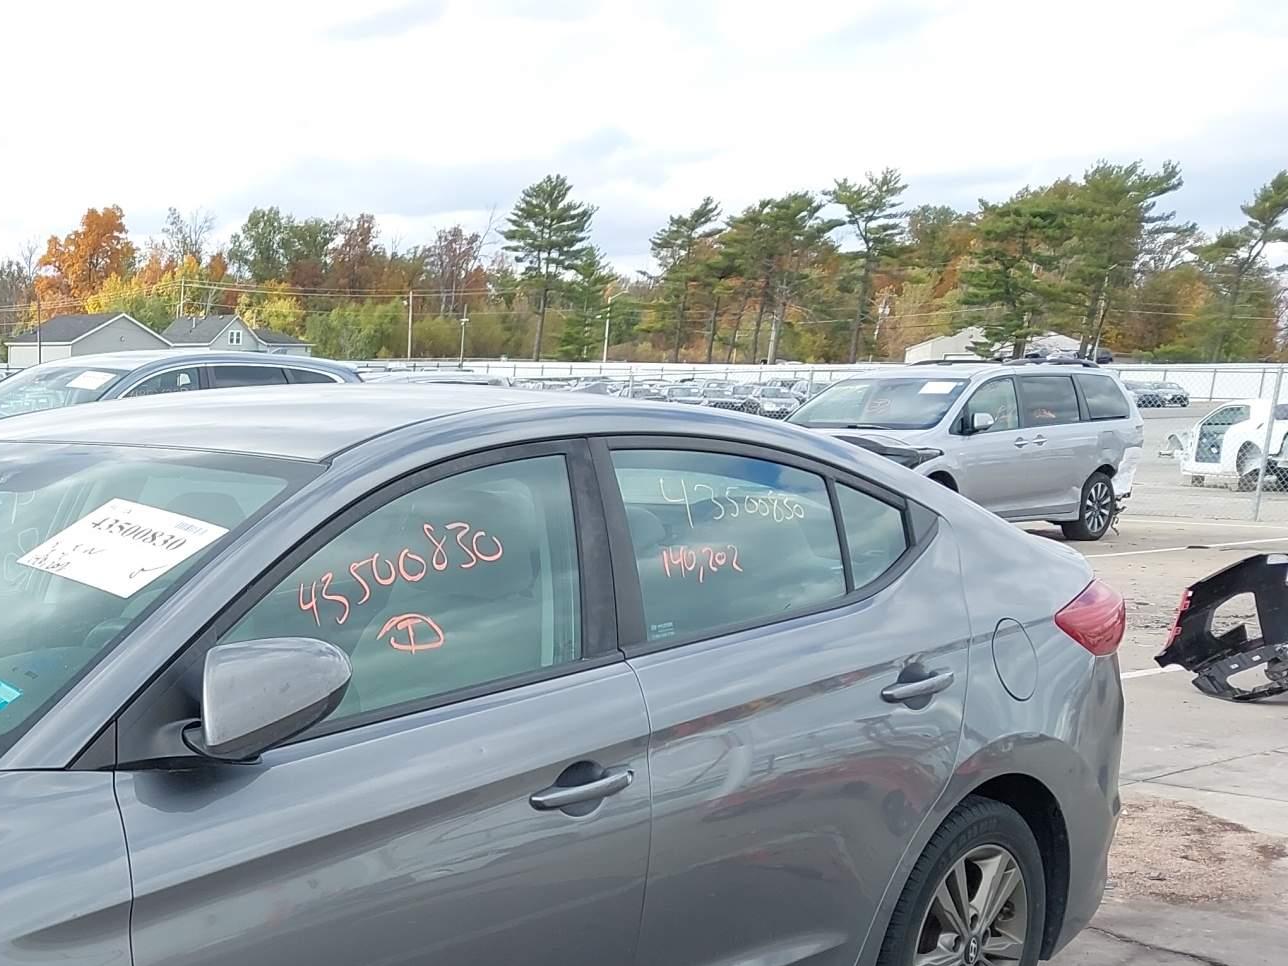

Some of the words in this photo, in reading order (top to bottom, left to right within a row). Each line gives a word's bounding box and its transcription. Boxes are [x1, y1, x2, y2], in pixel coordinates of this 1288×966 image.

[91, 516, 188, 551] 43500830
[298, 522, 503, 627] 43500830
[663, 545, 743, 583] 140,202
